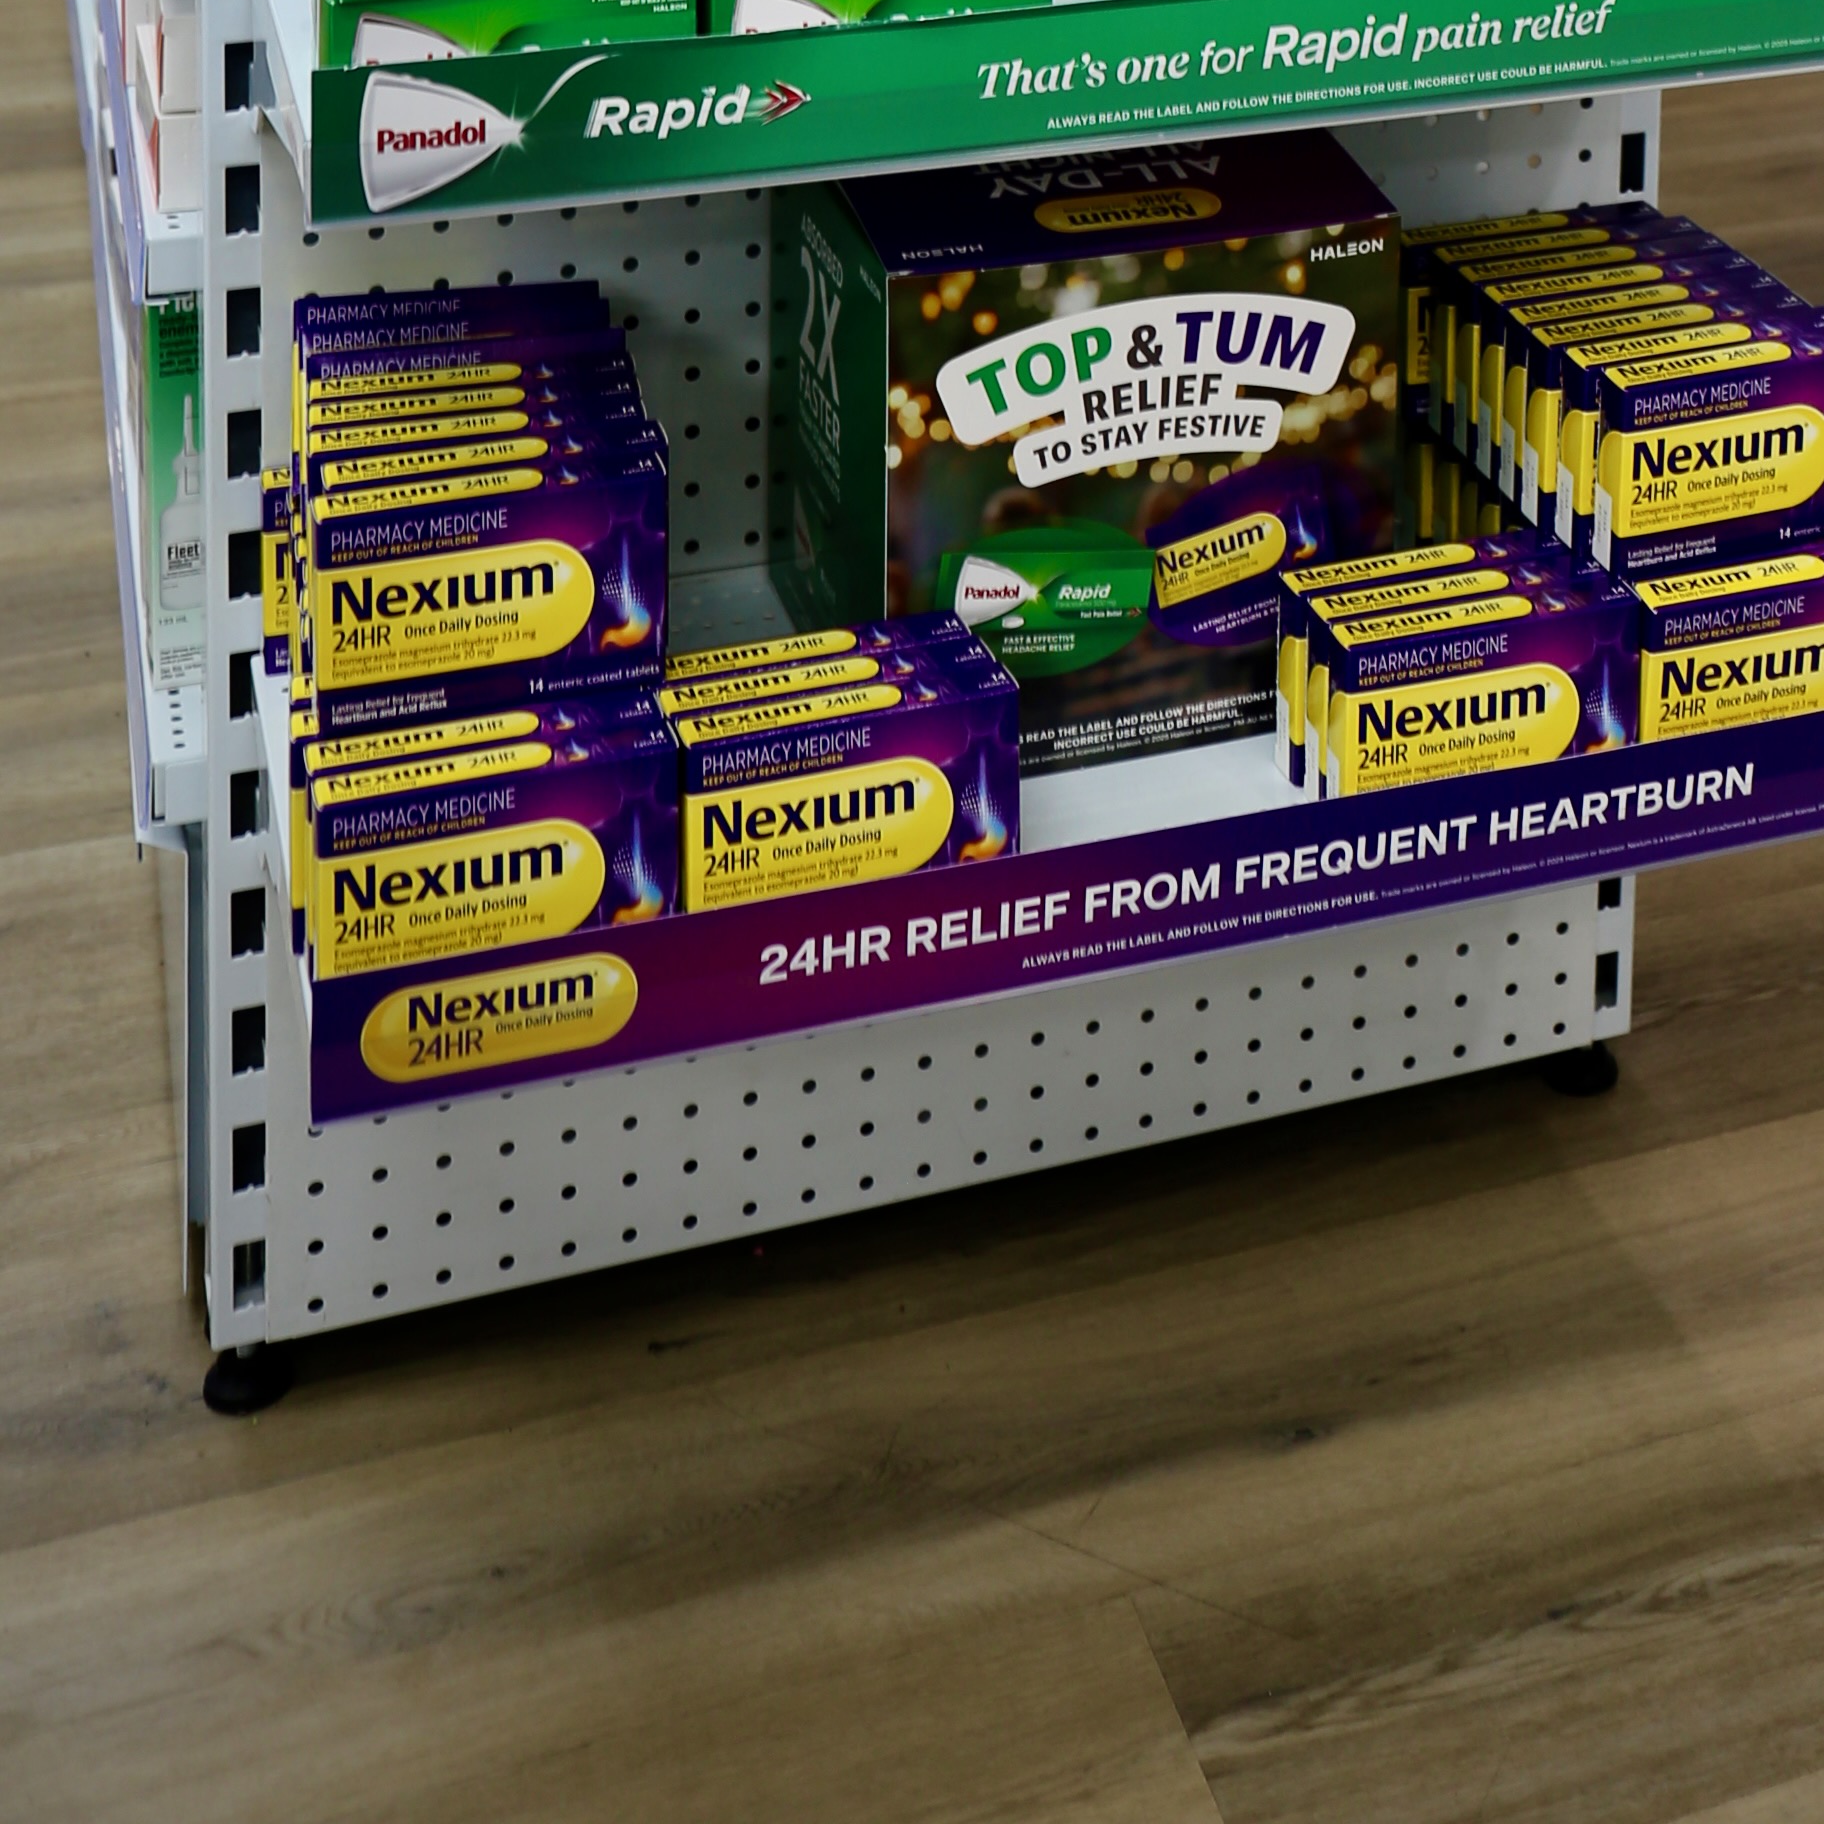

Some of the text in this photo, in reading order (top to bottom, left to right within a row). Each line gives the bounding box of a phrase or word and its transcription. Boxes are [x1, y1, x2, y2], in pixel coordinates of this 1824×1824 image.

[1116, 50, 1190, 84] one
[1200, 40, 1254, 76] for
[1262, 12, 1408, 73] Rapid
[1411, 12, 1502, 62] pain
[377, 118, 486, 154] Panadol
[583, 84, 750, 140] Rapid
[967, 311, 1325, 416] TOP & TUM
[1081, 374, 1223, 424] RELIEF
[1032, 414, 1266, 470] TO STAY FESTIVE
[331, 508, 508, 551] PHARMACY MEDICINE
[331, 562, 554, 626] Nexium
[332, 611, 519, 653] 24HR Once Daily Dosing
[529, 664, 660, 694] 14 enteric coated tablets
[759, 924, 892, 986] 24HR
[906, 891, 1070, 957] RELIEF
[1084, 862, 1221, 924] FROM
[1234, 814, 1477, 896] FREQUENT
[1488, 762, 1754, 846] HEARTBURN
[407, 969, 594, 1033] Nexium
